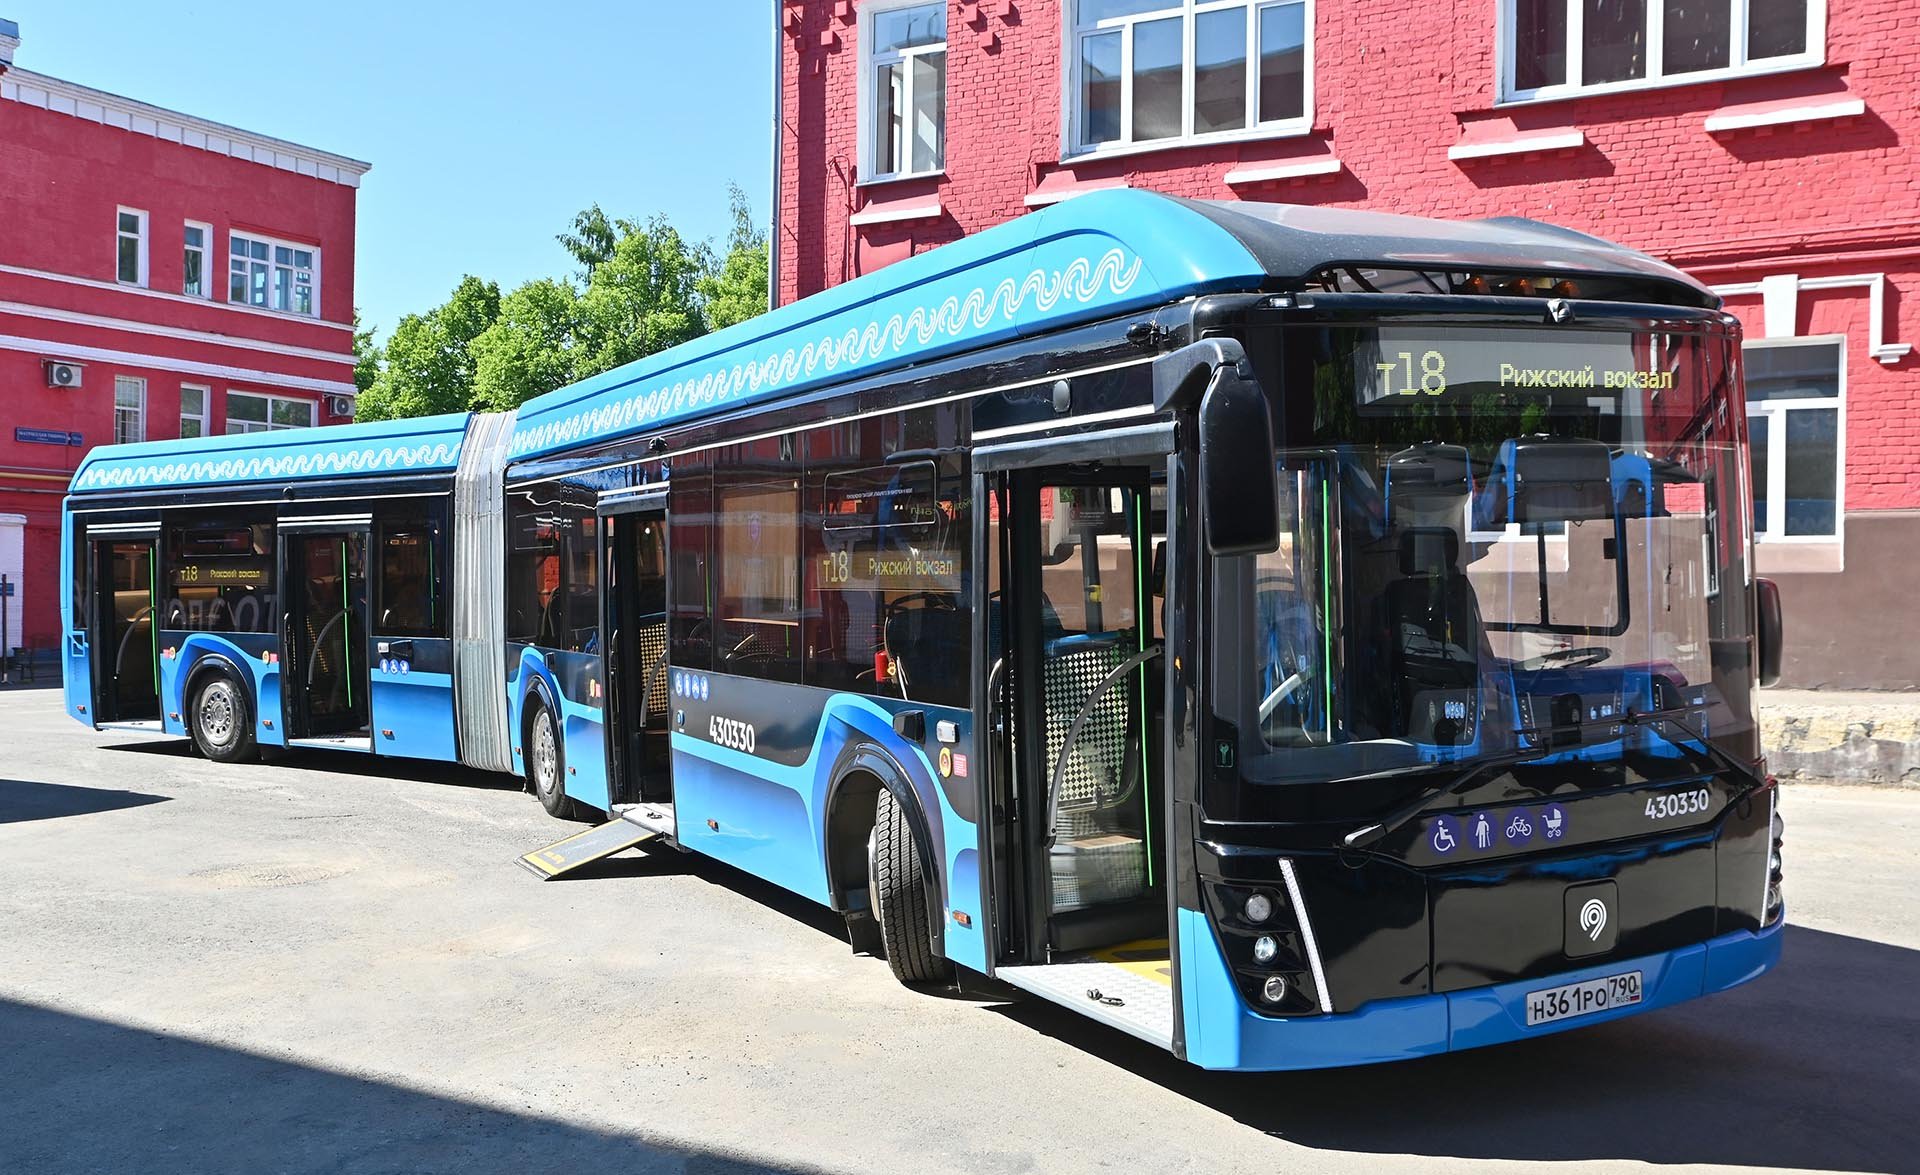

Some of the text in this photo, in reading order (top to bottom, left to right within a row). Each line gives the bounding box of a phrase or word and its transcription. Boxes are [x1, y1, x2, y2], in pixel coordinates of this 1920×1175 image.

[1500, 363, 1594, 388] Рижский
[1604, 370, 1673, 389] вокзал
[868, 557, 912, 576] Рижский
[916, 559, 953, 575] вокзал
[709, 715, 755, 754] 430330
[1644, 788, 1709, 820] 430330
[1610, 975, 1637, 998] 790
